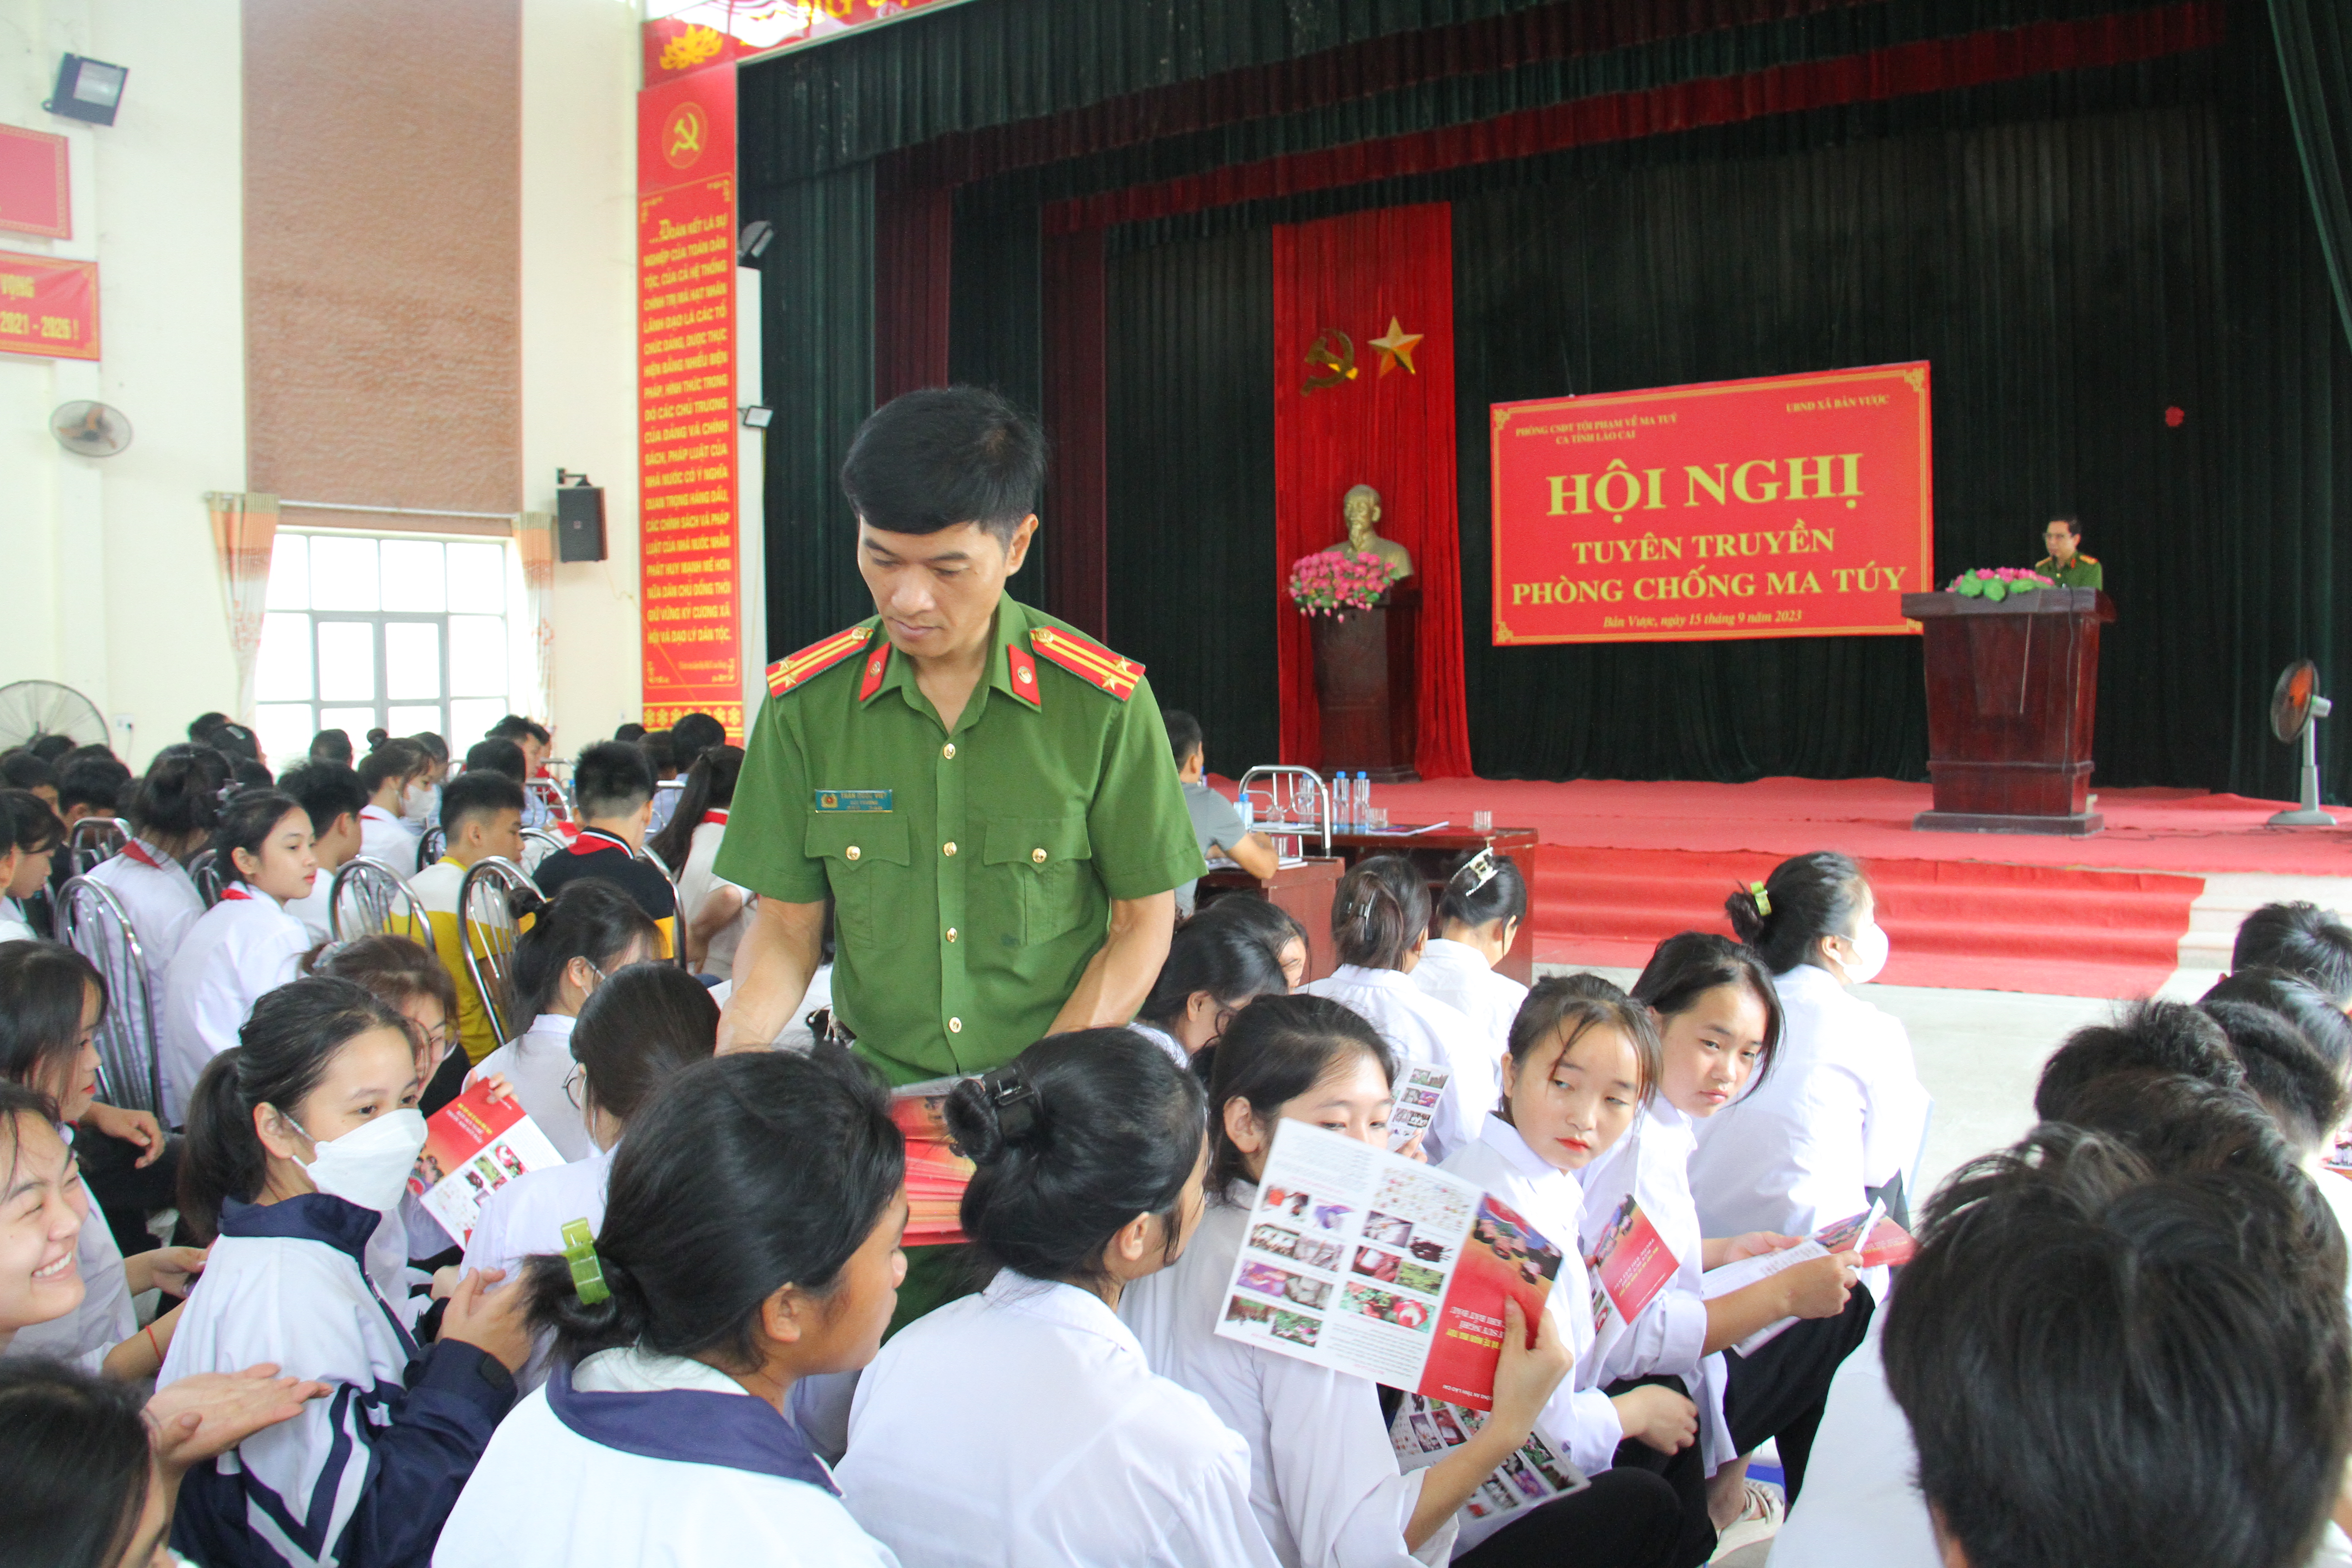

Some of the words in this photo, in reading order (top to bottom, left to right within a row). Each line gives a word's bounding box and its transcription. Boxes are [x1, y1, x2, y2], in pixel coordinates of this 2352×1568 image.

[0, 310, 29, 335] 2021
[73, 319, 79, 340] !
[645, 426, 662, 444] CỦA
[663, 423, 688, 441] ĐẢNG
[688, 421, 701, 436] VÀ
[702, 417, 729, 435] CHÍNH
[1556, 436, 1569, 445] CA
[1596, 431, 1616, 441] LÀO
[1617, 431, 1636, 439] CAI
[668, 446, 688, 462] PHÁP
[689, 443, 710, 462] LUẬT
[710, 439, 729, 456] CỦA
[645, 471, 661, 487] NHÀ
[662, 470, 683, 485] NƯỚC
[684, 467, 696, 483] CÓ
[697, 466, 703, 480] Ý
[704, 463, 729, 480] NGHĨA
[1546, 458, 1666, 523] HỘI
[1684, 452, 1863, 509] NGHỊ
[646, 517, 660, 532] CÁC
[661, 516, 680, 531] CHÍNH
[681, 513, 699, 528] SÁCH
[700, 511, 710, 526] VÀ
[711, 509, 730, 524] PHÁP
[1573, 532, 1683, 565] TUYÊN
[1692, 519, 1835, 560] TRUYỀN
[1512, 575, 1624, 605] PHÒNG
[1634, 564, 1755, 601] CHỐNG
[1766, 570, 1822, 595] MA
[1833, 560, 1907, 592] TÚY
[1661, 612, 1685, 628] ngày
[1690, 613, 1701, 625] 15
[1703, 610, 1735, 626] tháng
[1738, 611, 1745, 623] 9
[1747, 612, 1772, 623] năm
[1775, 610, 1803, 622] 2023
